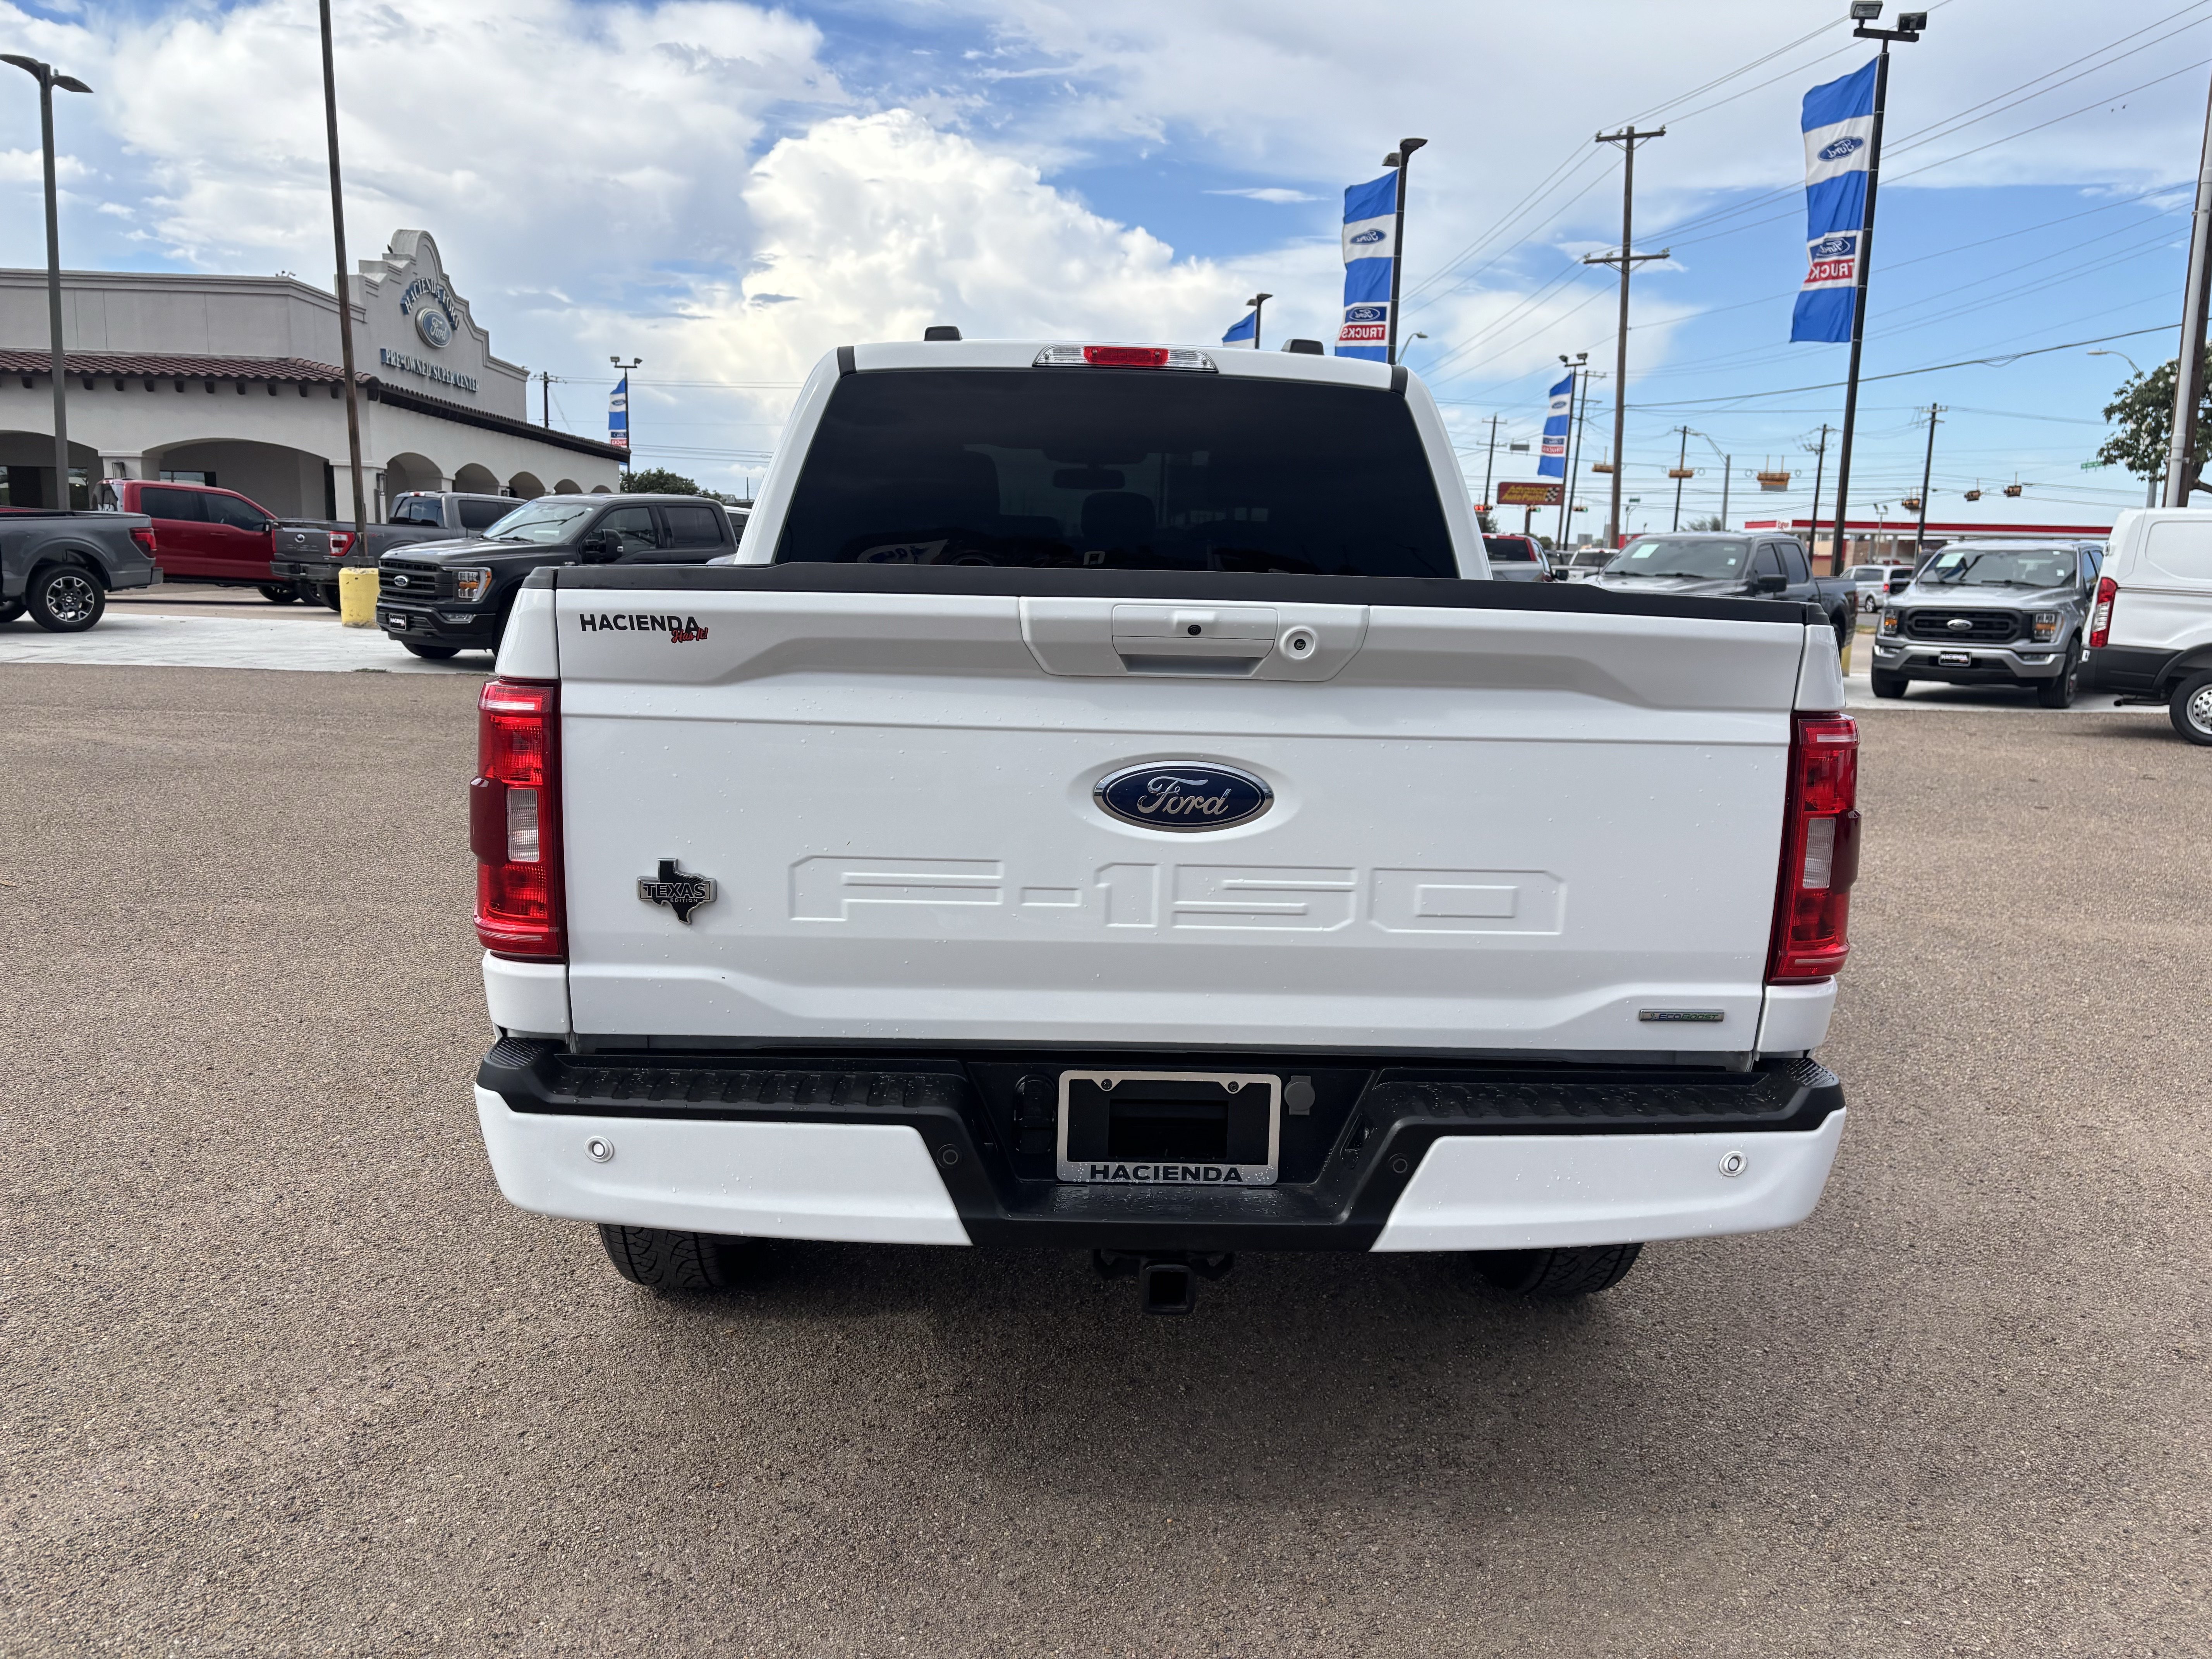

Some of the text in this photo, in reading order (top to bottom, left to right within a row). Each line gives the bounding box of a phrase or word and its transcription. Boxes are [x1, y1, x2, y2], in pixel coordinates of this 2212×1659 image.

[430, 317, 447, 340] Ford
[386, 349, 431, 377] PRE-OWNED
[433, 365, 455, 384] SUPER
[579, 613, 699, 633] HACIENDA
[671, 629, 694, 643] Has
[1137, 776, 1231, 815] Ford
[643, 883, 706, 899] TEXAS
[788, 856, 1567, 936] F-150
[1090, 1164, 1243, 1183] HACIENDA
